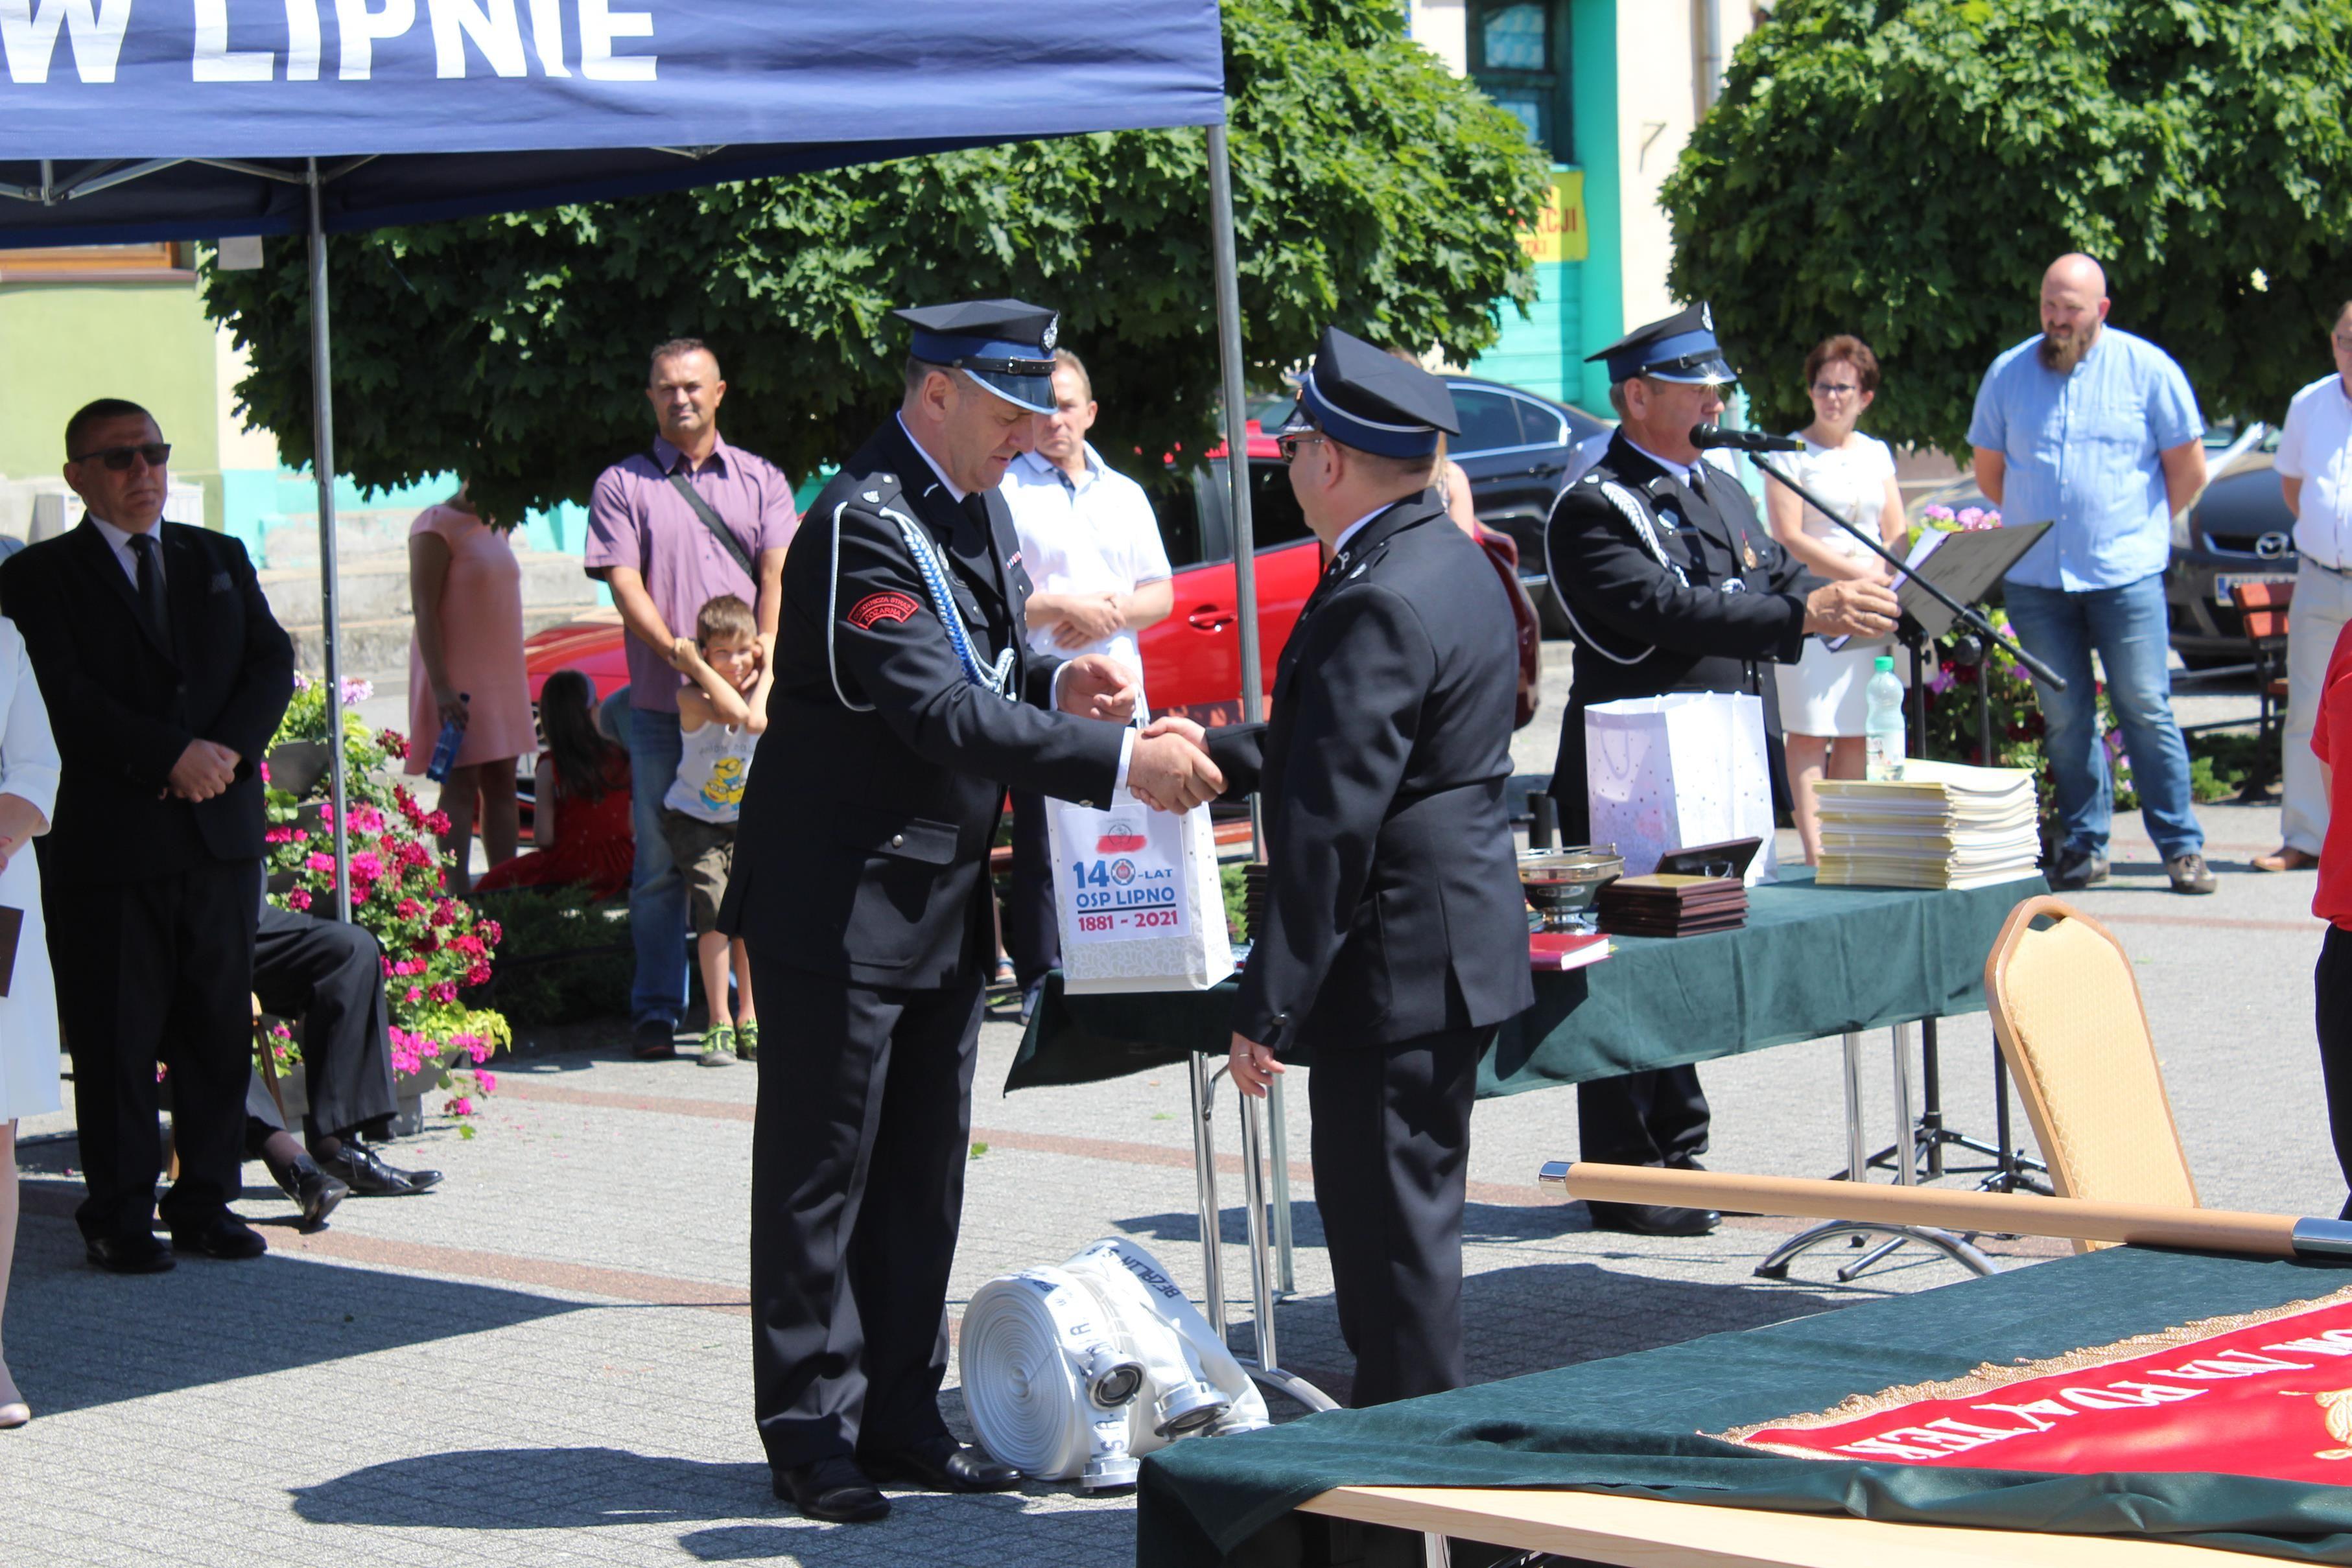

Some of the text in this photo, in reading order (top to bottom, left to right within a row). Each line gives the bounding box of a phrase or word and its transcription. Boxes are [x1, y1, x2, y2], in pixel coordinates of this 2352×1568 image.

[0, 0, 657, 83] W LIPNIE
[1077, 887, 1175, 907] OSP LIPNO
[1079, 915, 1114, 931] 1881
[1135, 910, 1178, 928] 2021
